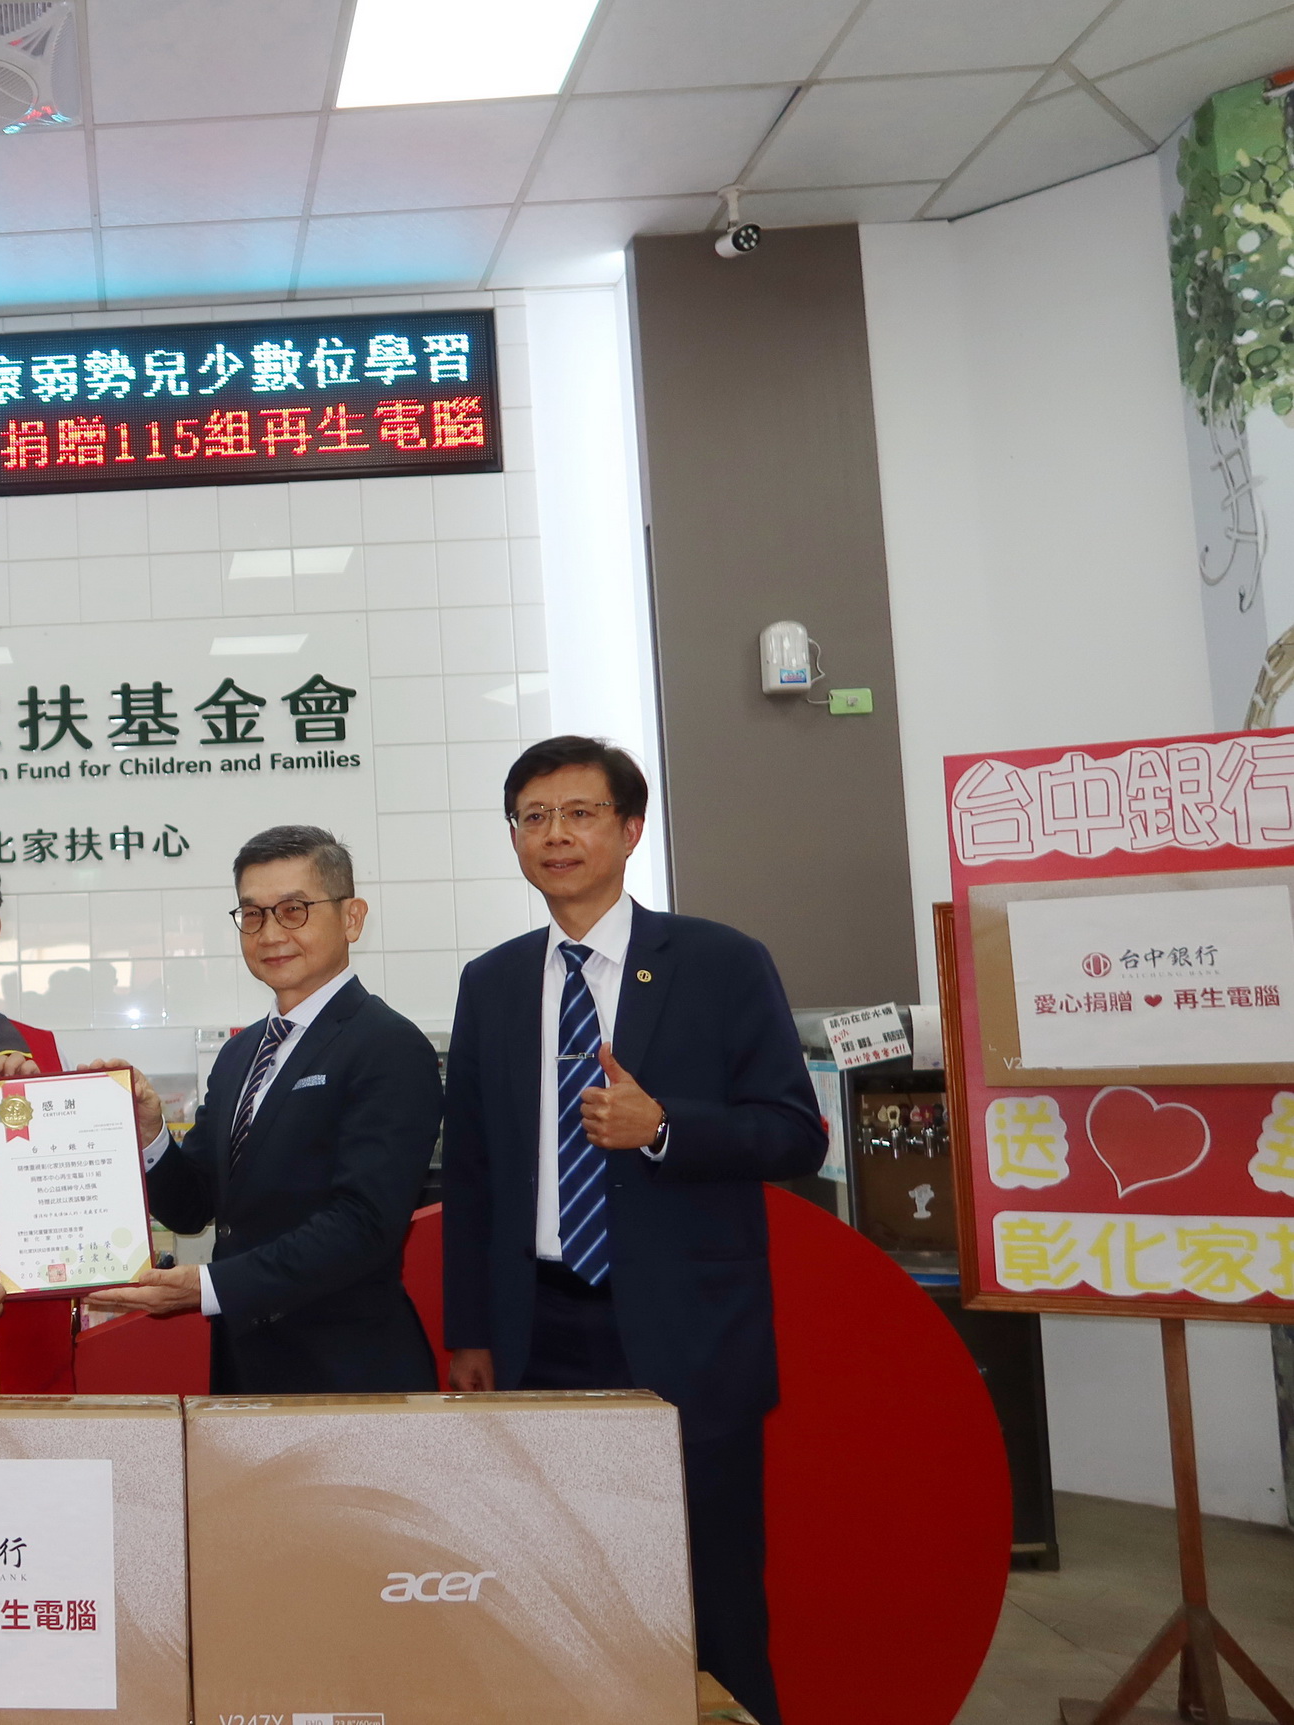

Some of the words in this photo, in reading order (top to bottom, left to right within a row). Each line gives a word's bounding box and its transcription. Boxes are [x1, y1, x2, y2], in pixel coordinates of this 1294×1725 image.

[1, 396, 485, 471] 捐贈115組再生電腦
[17, 761, 71, 780] Fund
[79, 759, 112, 778] for
[119, 756, 213, 777] Children
[220, 753, 262, 772] and
[270, 749, 361, 771] Families
[954, 740, 1294, 860] 台中銀行
[1119, 944, 1218, 970] 台中銀行
[1034, 990, 1133, 1015] 愛心捐贈
[1173, 985, 1281, 1010] 再生電腦
[42, 1099, 76, 1112] 感謝
[42, 1110, 77, 1118] CERTIFICATE
[993, 1099, 1059, 1180] 送
[379, 1571, 497, 1602] acer
